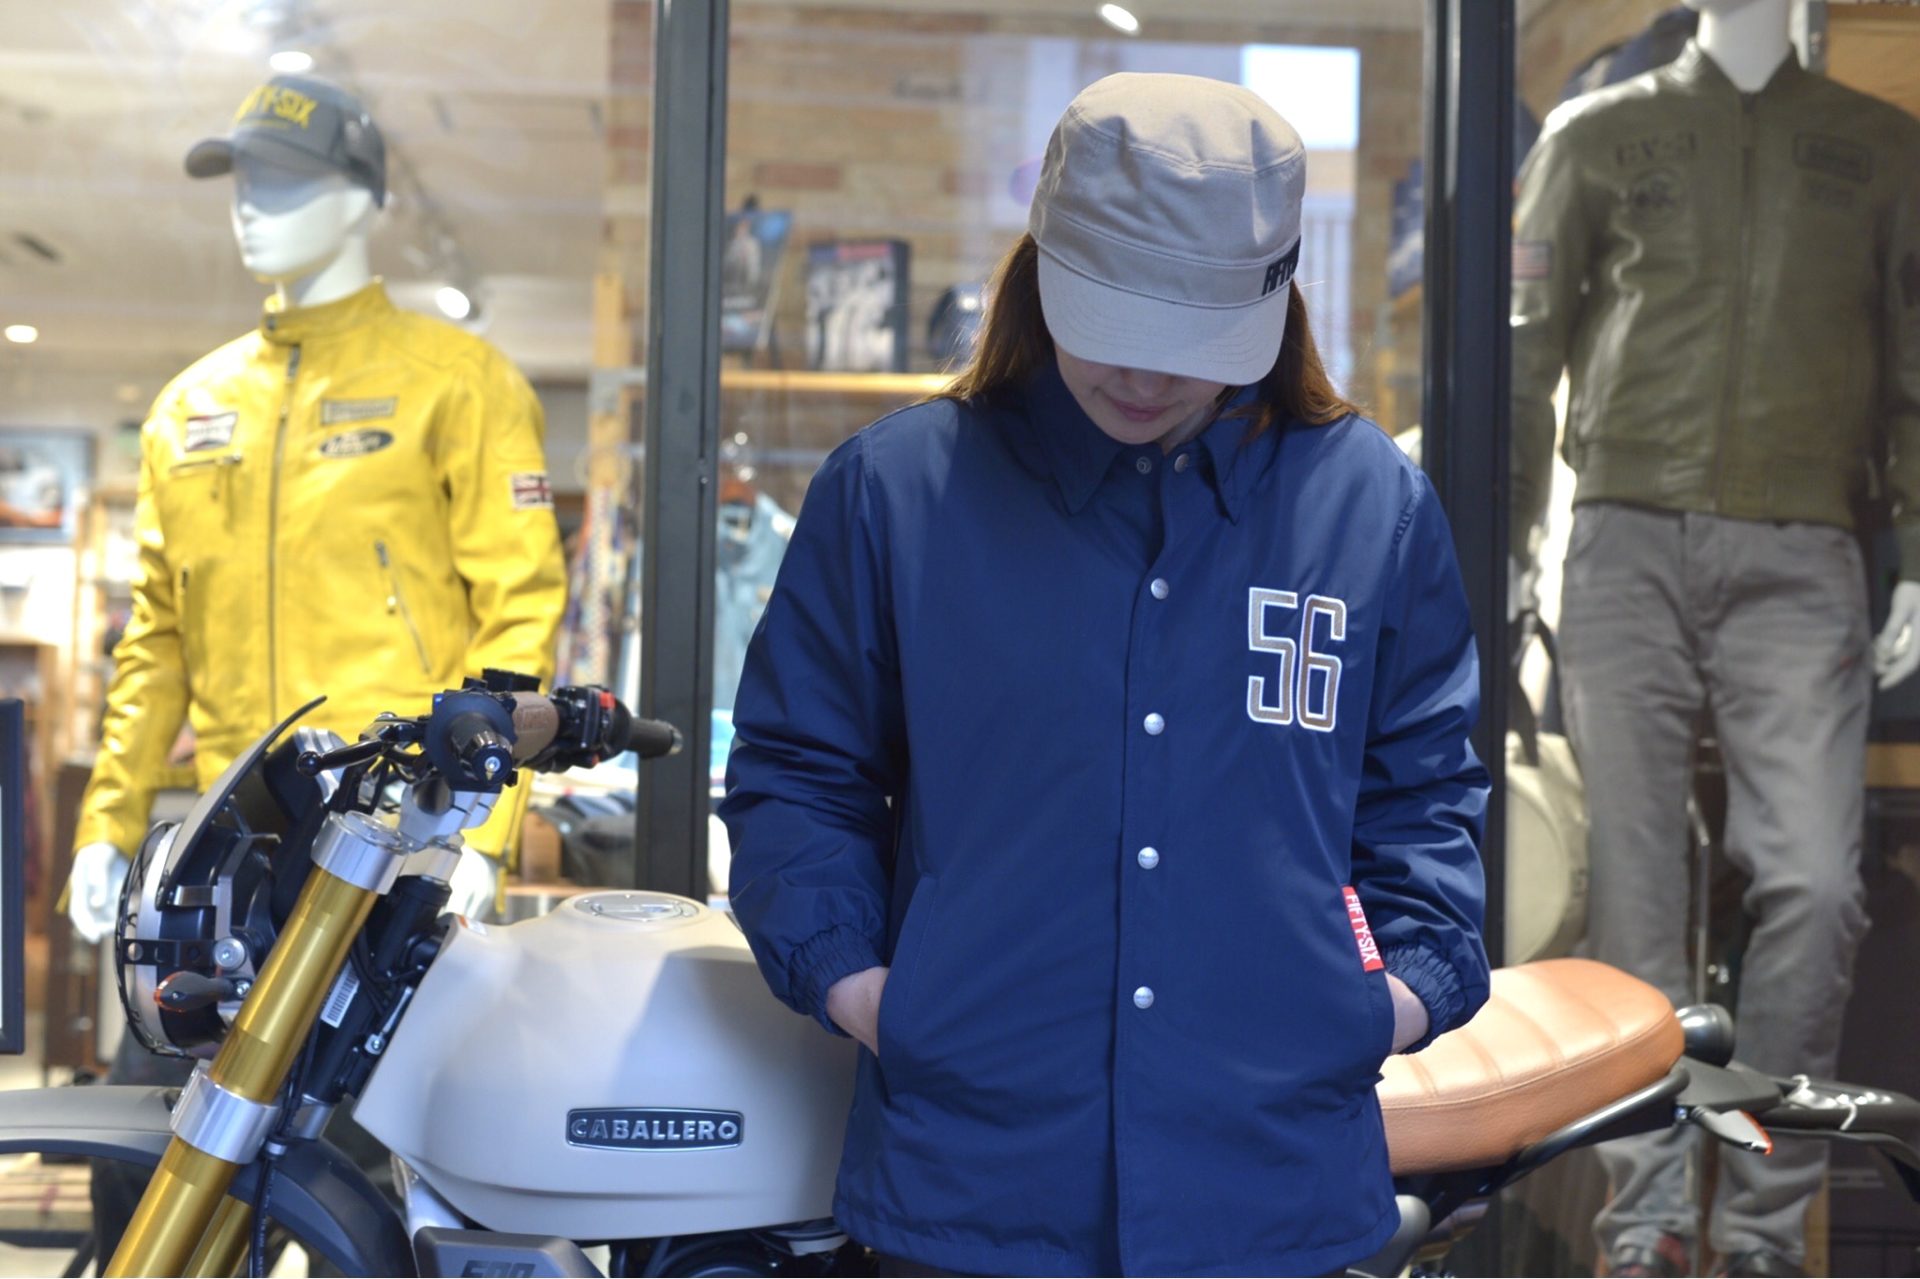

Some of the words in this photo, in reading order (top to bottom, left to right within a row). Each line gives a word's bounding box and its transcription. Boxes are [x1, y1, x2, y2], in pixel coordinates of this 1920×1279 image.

[1247, 587, 1346, 732] 56
[1344, 893, 1381, 964] FIFTY-SIX
[571, 1118, 738, 1141] CABALLERO
